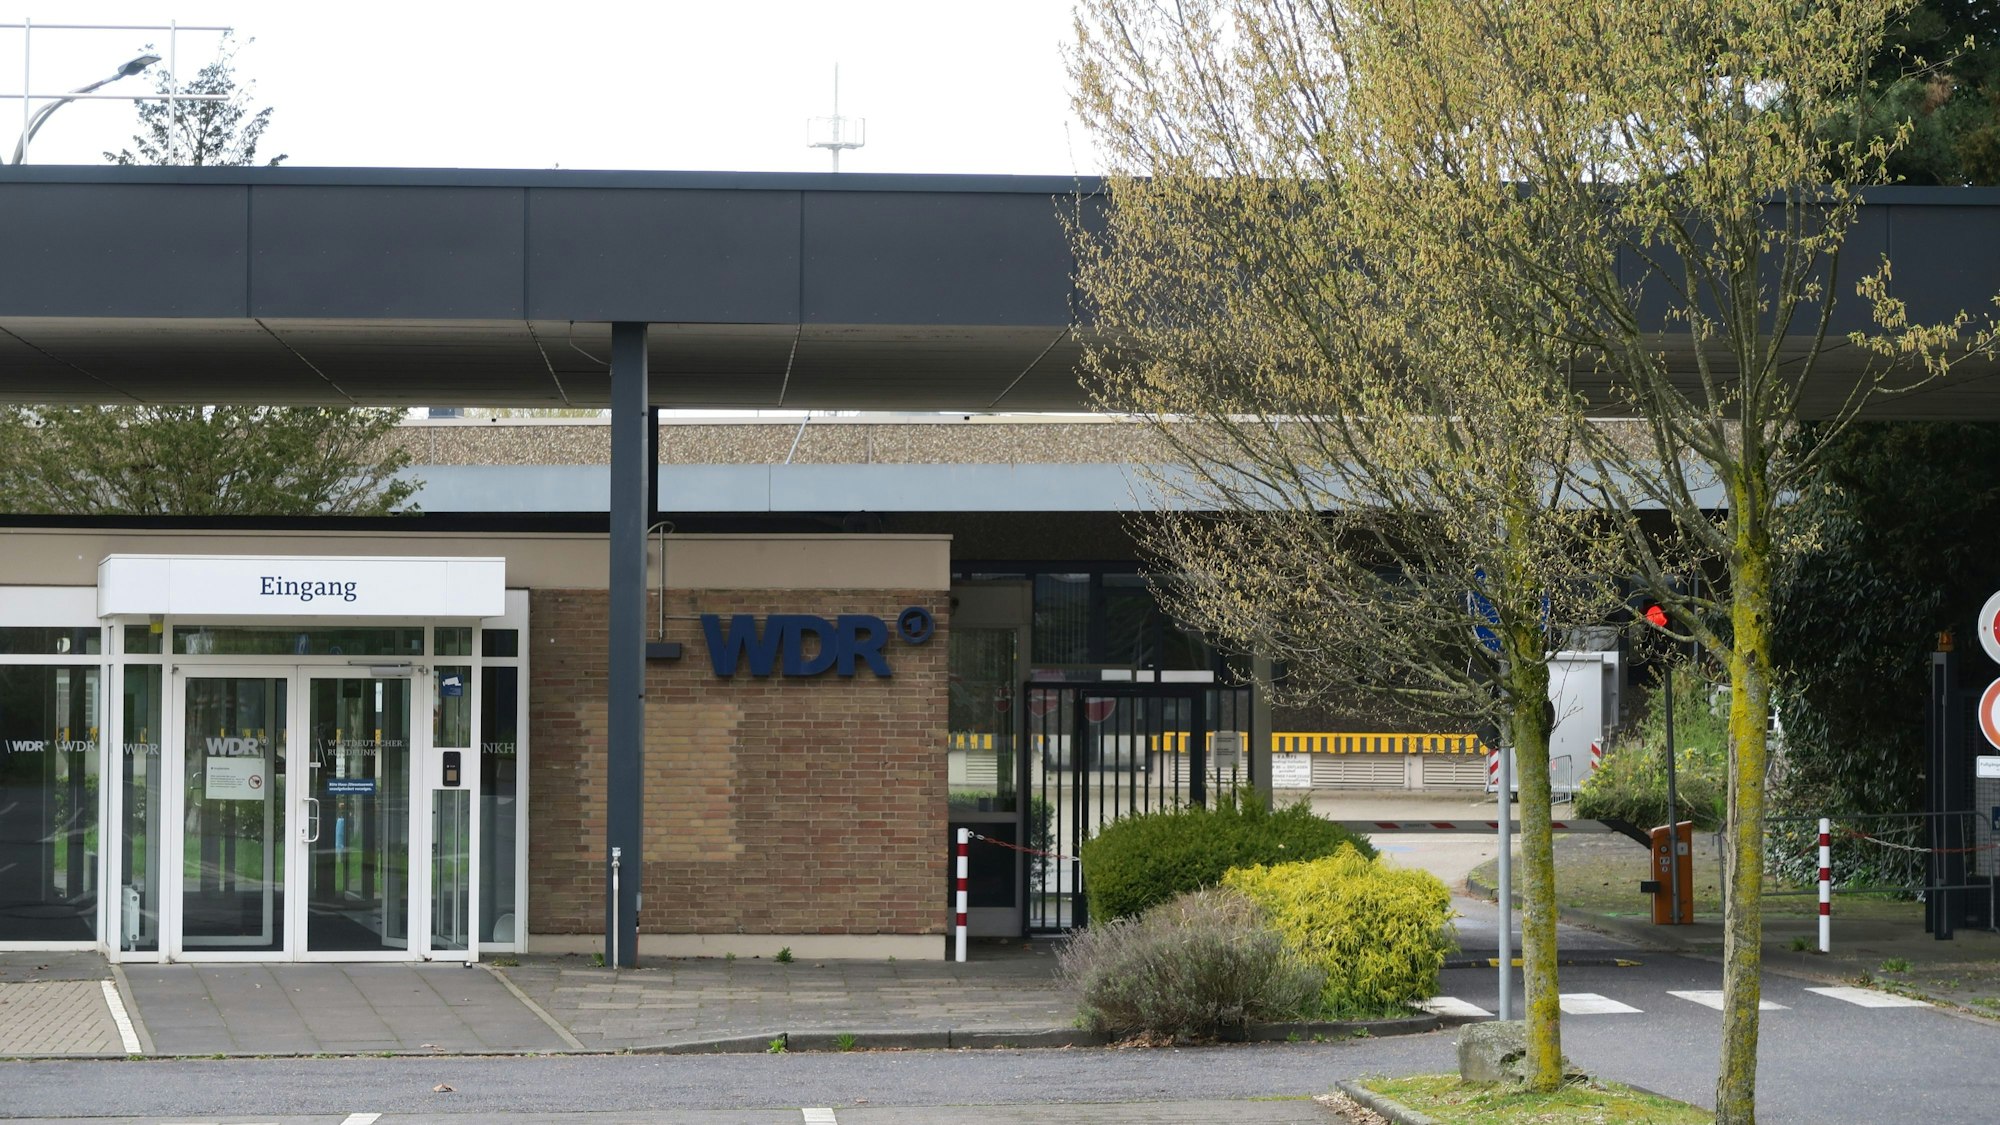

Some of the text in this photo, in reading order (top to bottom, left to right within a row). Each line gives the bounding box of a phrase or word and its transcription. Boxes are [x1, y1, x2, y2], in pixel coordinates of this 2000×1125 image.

[260, 576, 357, 602] Eingang
[700, 614, 892, 677] WDR
[123, 743, 160, 755] WDR
[206, 737, 259, 755] WDR
[327, 739, 402, 747] WSTDEUTCHER
[481, 742, 516, 754] NKH
